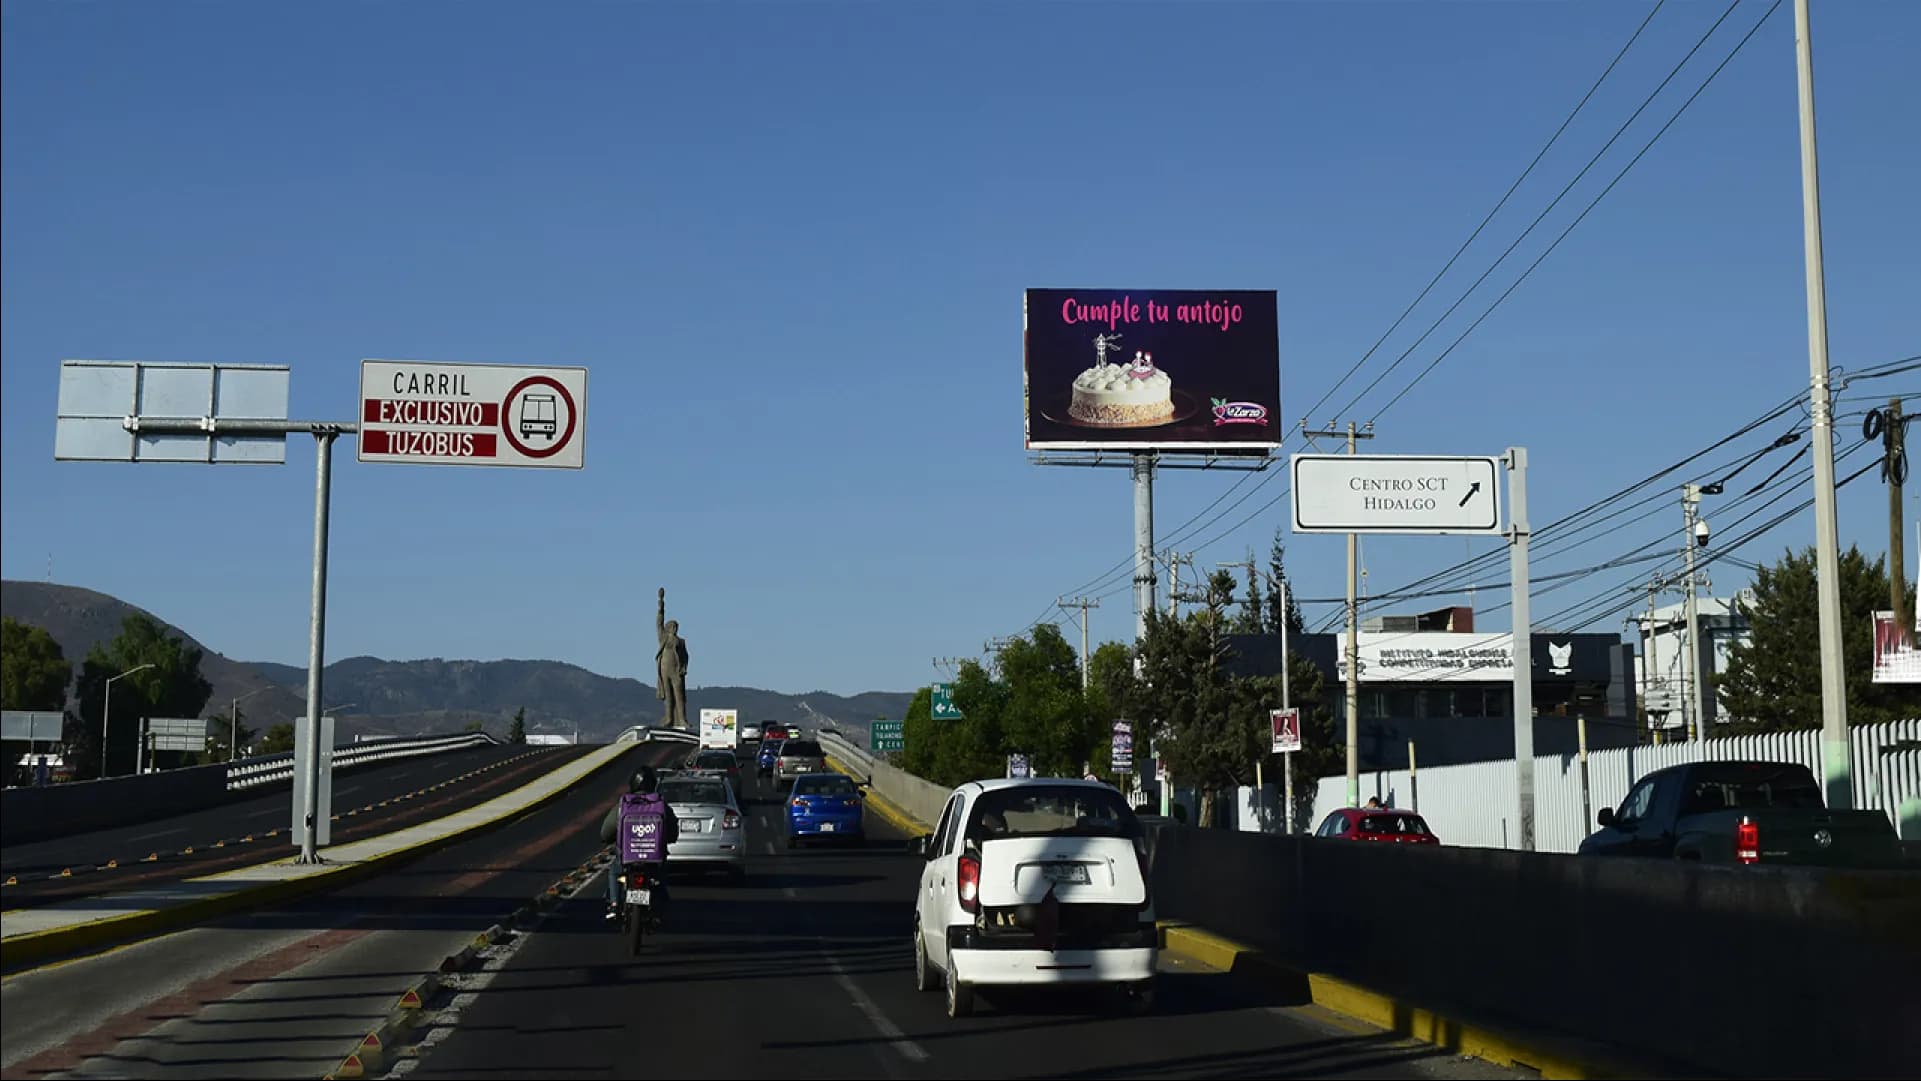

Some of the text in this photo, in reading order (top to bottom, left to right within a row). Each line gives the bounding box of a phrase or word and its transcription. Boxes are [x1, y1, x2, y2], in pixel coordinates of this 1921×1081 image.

[1062, 296, 1243, 331] Cumple tu antojo
[393, 371, 471, 396] CARRIL
[379, 400, 483, 426] EXCLUSIVO
[386, 431, 475, 457] TUZOBUS
[1349, 476, 1449, 491] CENTRO SCT
[1364, 496, 1437, 511] HIDALGO
